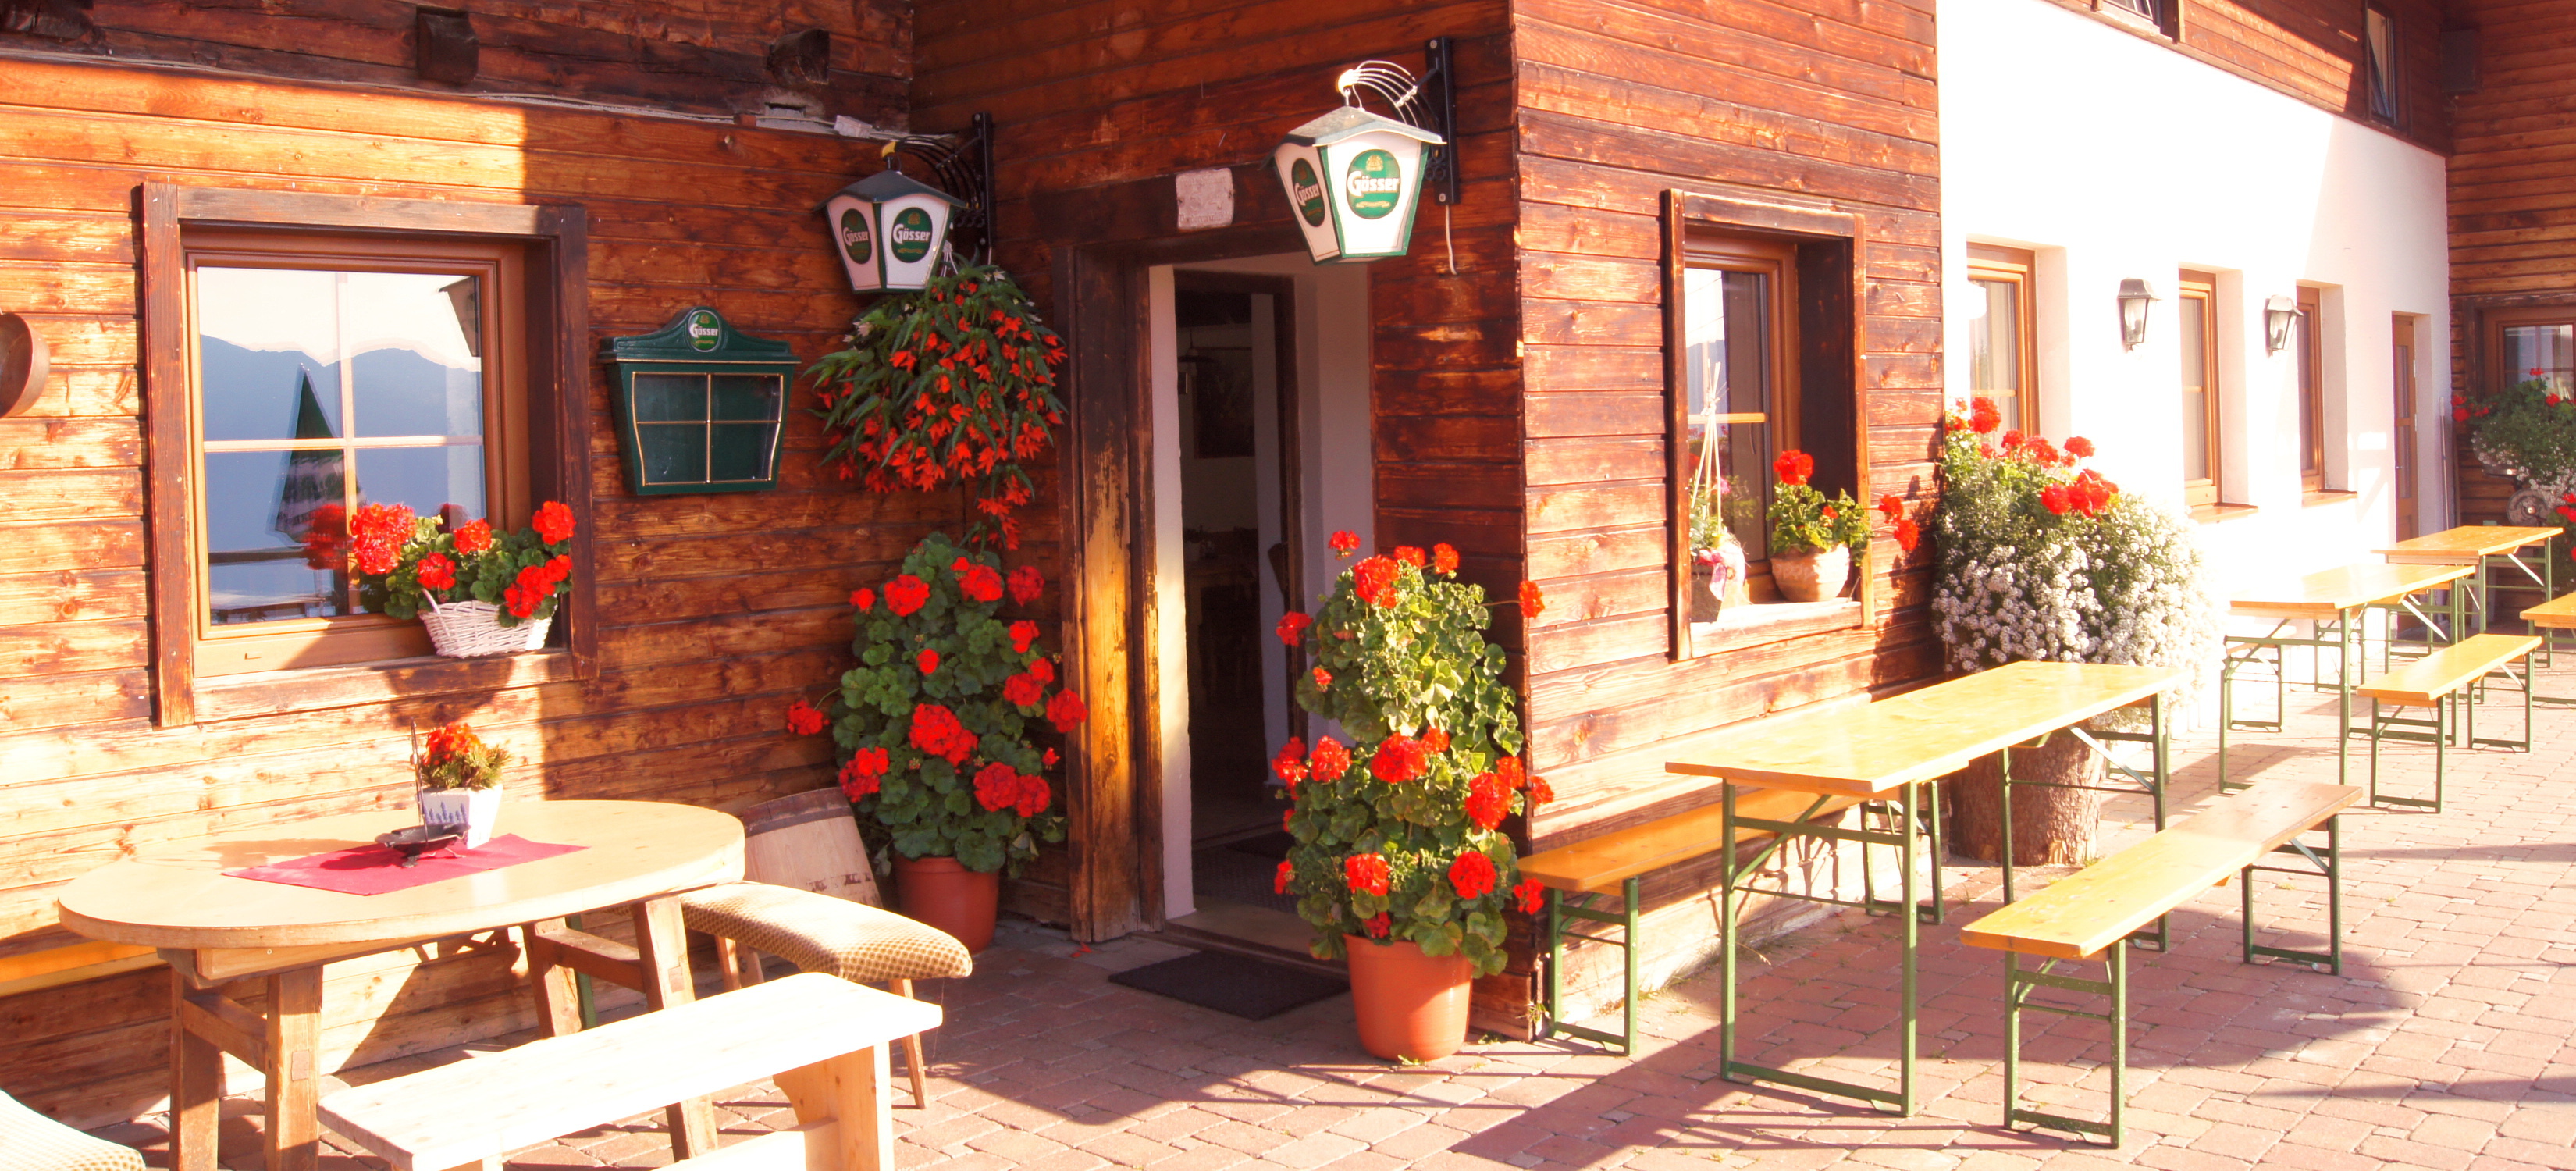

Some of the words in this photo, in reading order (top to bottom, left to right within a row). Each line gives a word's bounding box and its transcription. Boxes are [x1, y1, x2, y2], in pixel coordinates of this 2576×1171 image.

[1347, 170, 1400, 197] Gösser
[843, 226, 869, 247] Gösser
[892, 223, 931, 244] Gösser
[688, 322, 719, 339] Gösser
